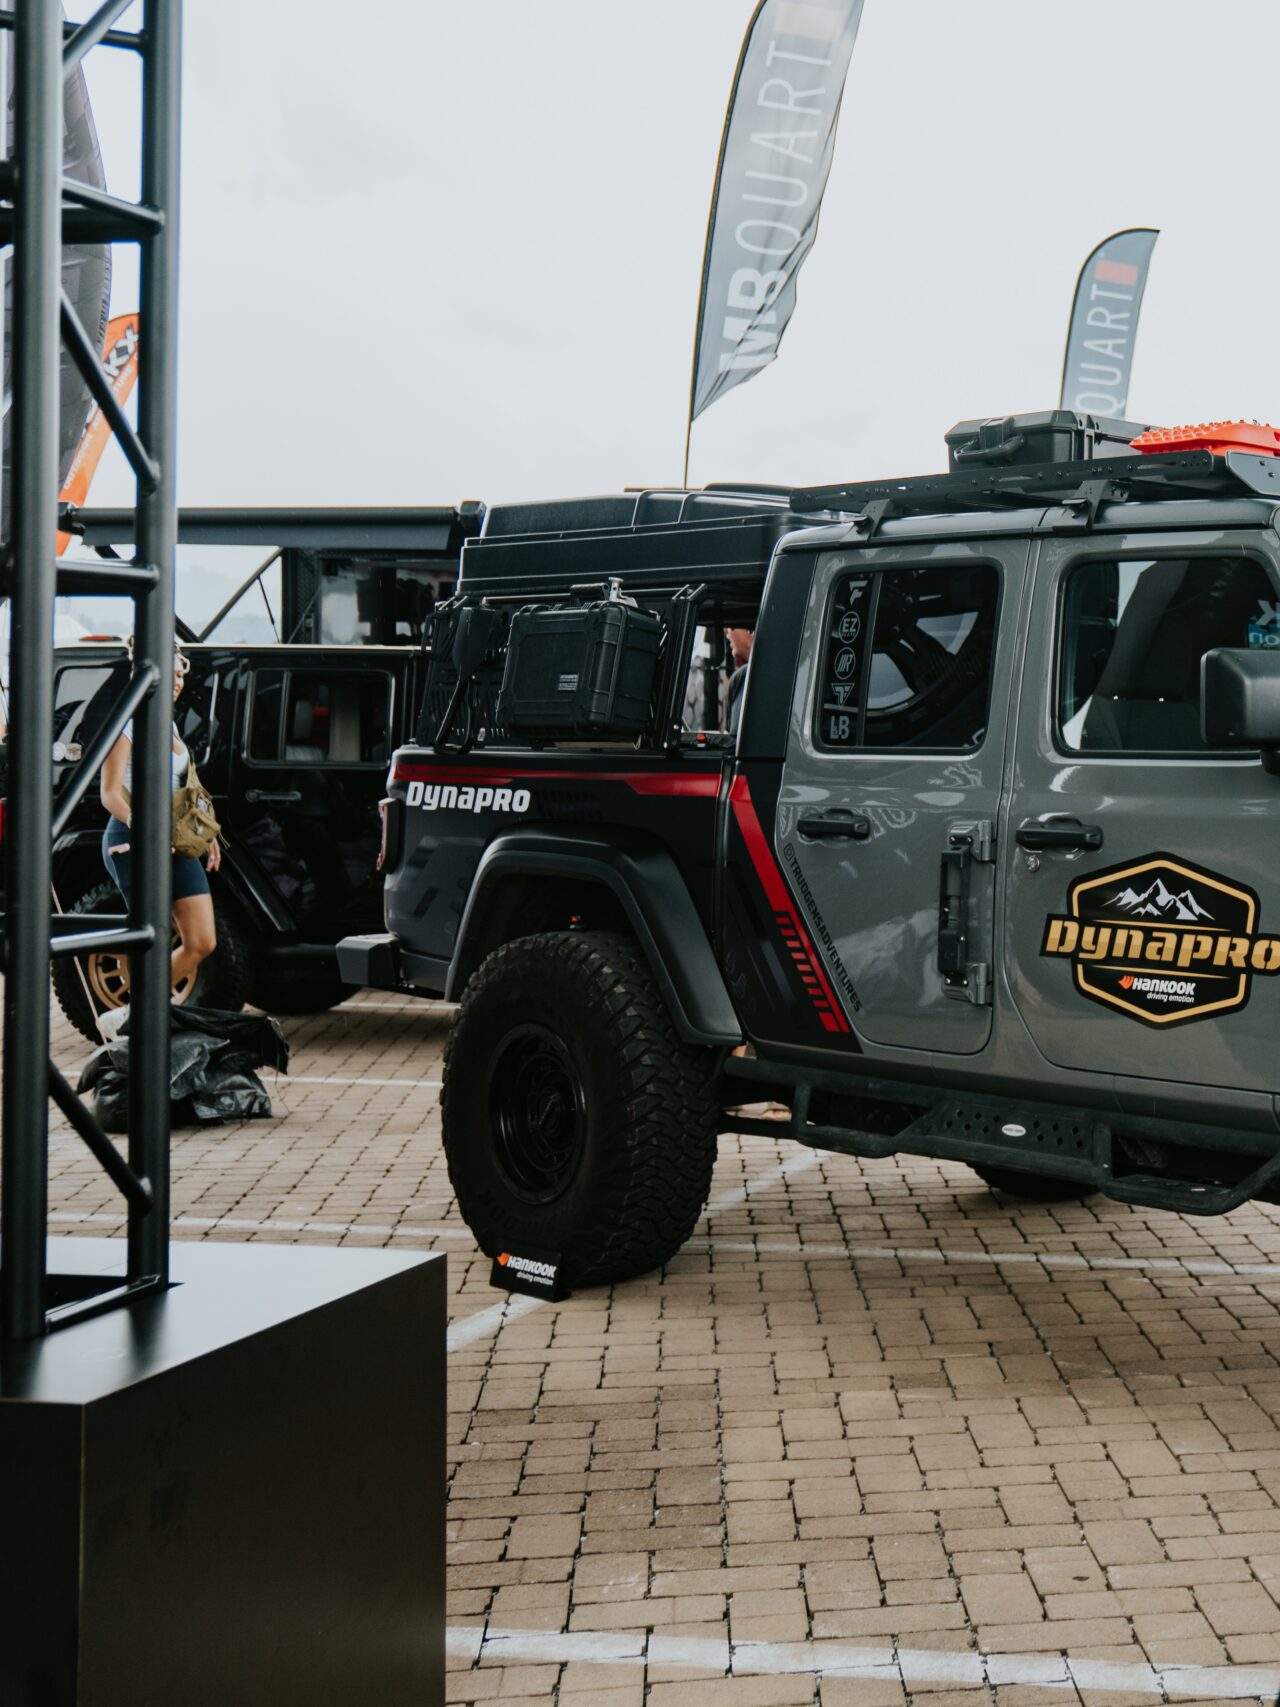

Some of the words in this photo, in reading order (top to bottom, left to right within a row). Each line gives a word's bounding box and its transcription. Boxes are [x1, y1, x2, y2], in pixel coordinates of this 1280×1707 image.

[842, 618, 857, 633] EZ
[790, 857, 863, 1012] TRUDGENSADVENTURES
[1146, 992, 1168, 1002] driving
[1168, 995, 1194, 1003] emotion
